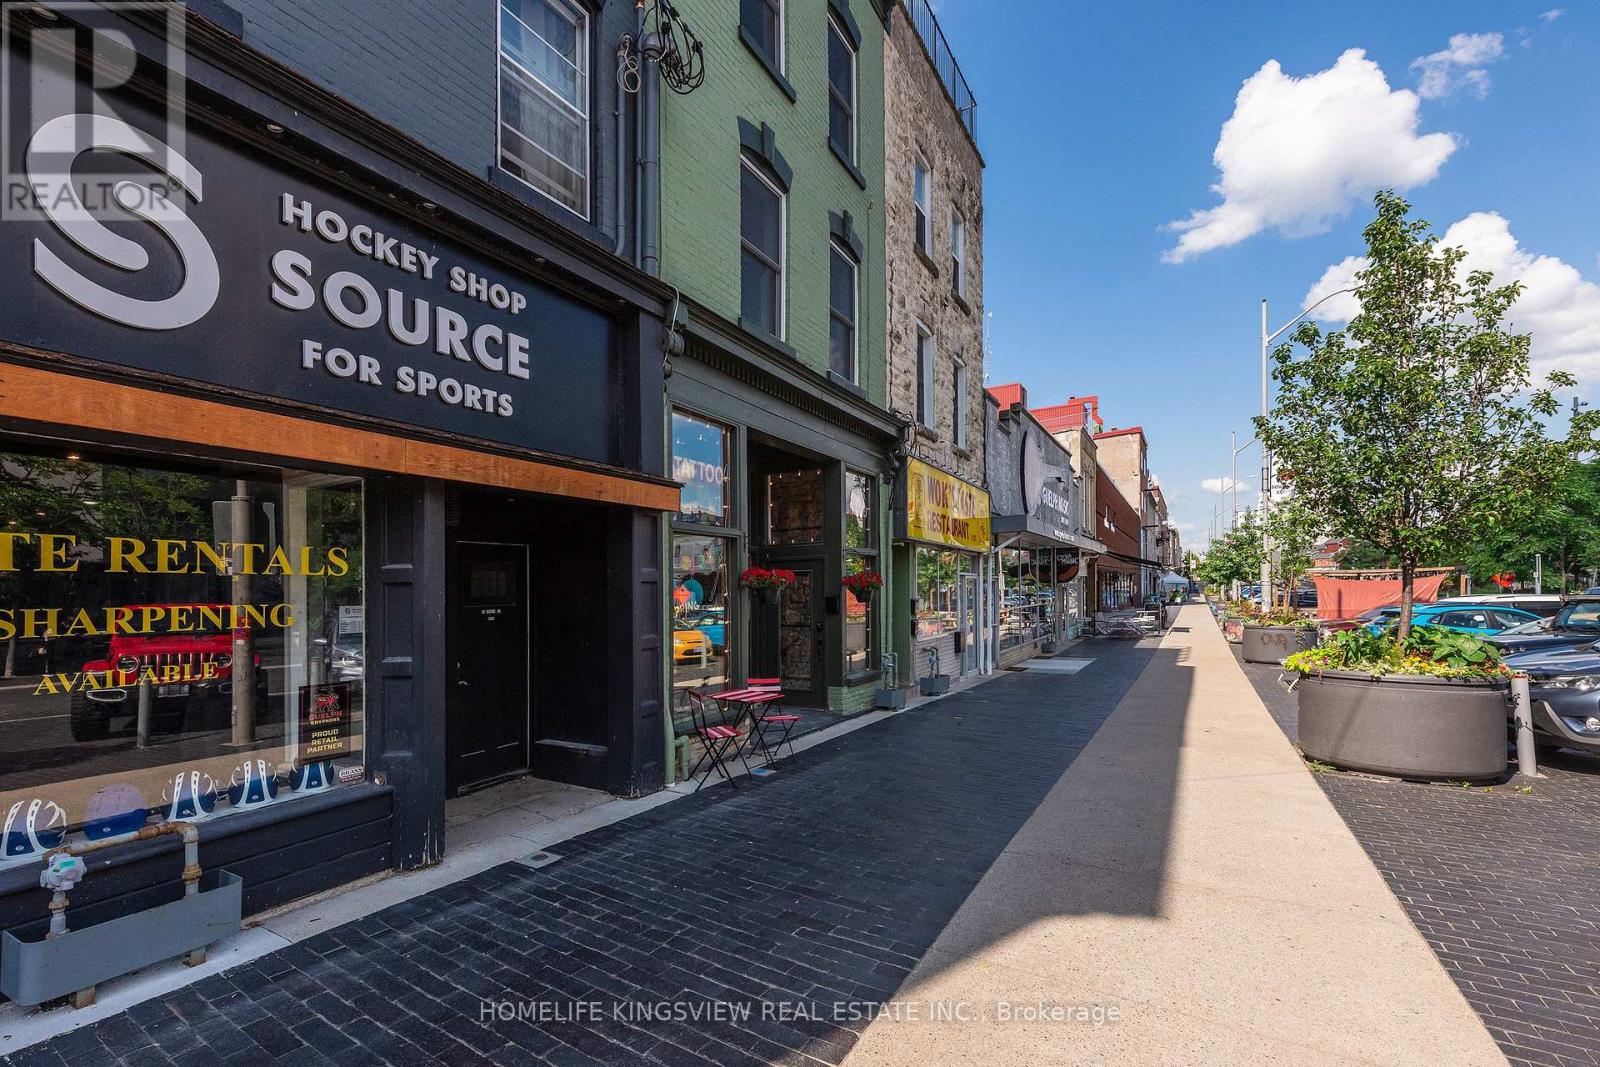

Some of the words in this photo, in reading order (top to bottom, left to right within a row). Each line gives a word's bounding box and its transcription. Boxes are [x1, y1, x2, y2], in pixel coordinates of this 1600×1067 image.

[281, 191, 440, 280] HOCKEY
[449, 264, 527, 315] SHOP
[270, 249, 531, 379] SOURCE
[302, 338, 382, 386] FOR
[396, 365, 514, 417] SPORTS
[673, 456, 723, 484] TATTOO
[927, 475, 957, 511] WOK'
[927, 508, 970, 540] RESTAURANT
[105, 536, 349, 575] RENTALS
[0, 603, 297, 639] SHARPENING
[34, 662, 221, 696] AVAILABLE
[309, 710, 342, 721] GUELPH
[307, 743, 343, 754] PARTNER
[311, 728, 339, 738] PROUD
[311, 737, 339, 746] RETAIL
